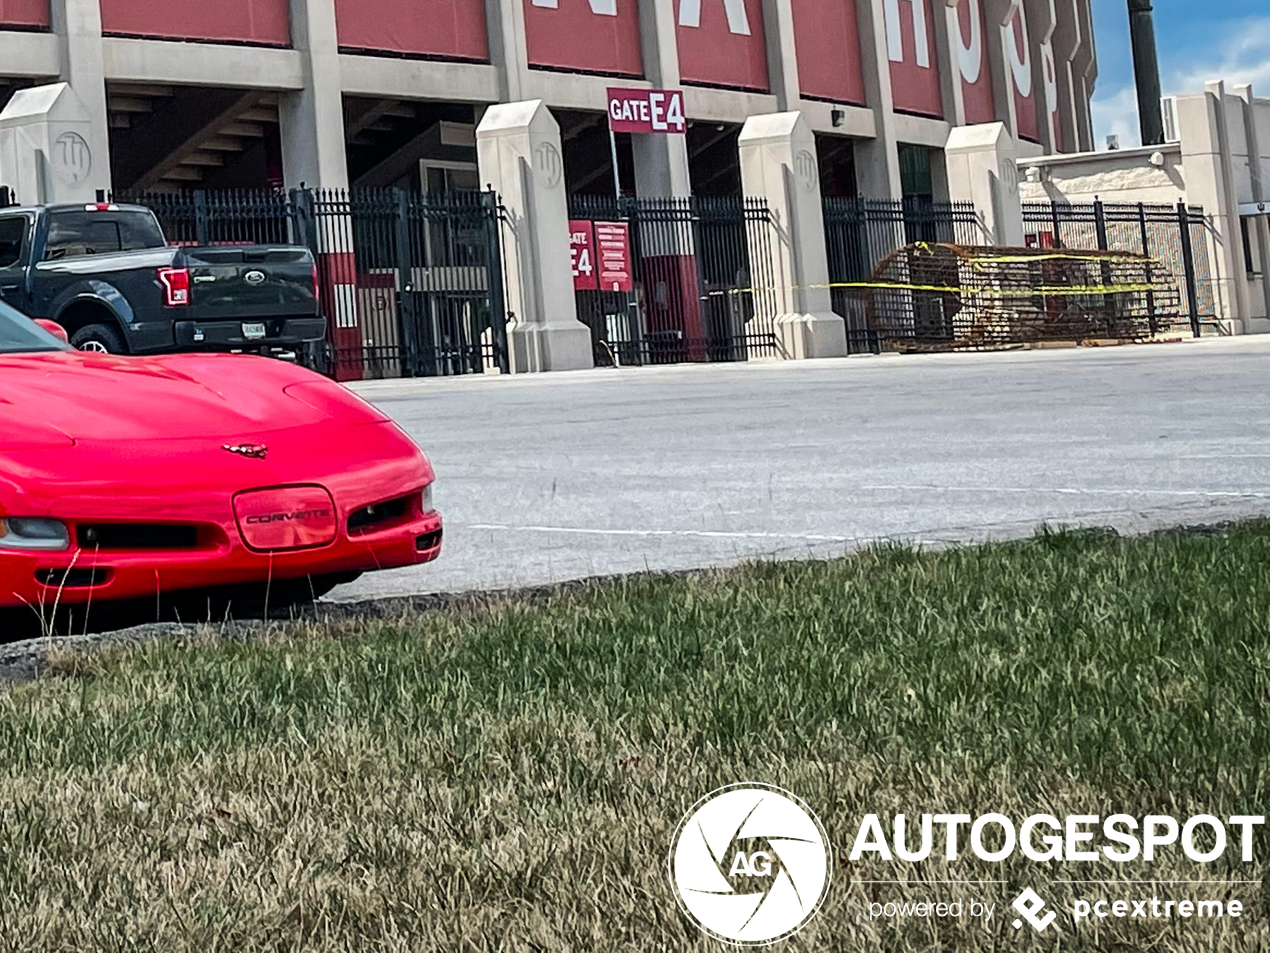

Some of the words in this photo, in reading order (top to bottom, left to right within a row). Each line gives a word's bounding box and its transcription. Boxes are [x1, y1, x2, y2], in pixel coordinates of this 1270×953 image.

[610, 98, 650, 122] GATE
[649, 92, 686, 131] E4
[245, 508, 331, 525] CORVETTE
